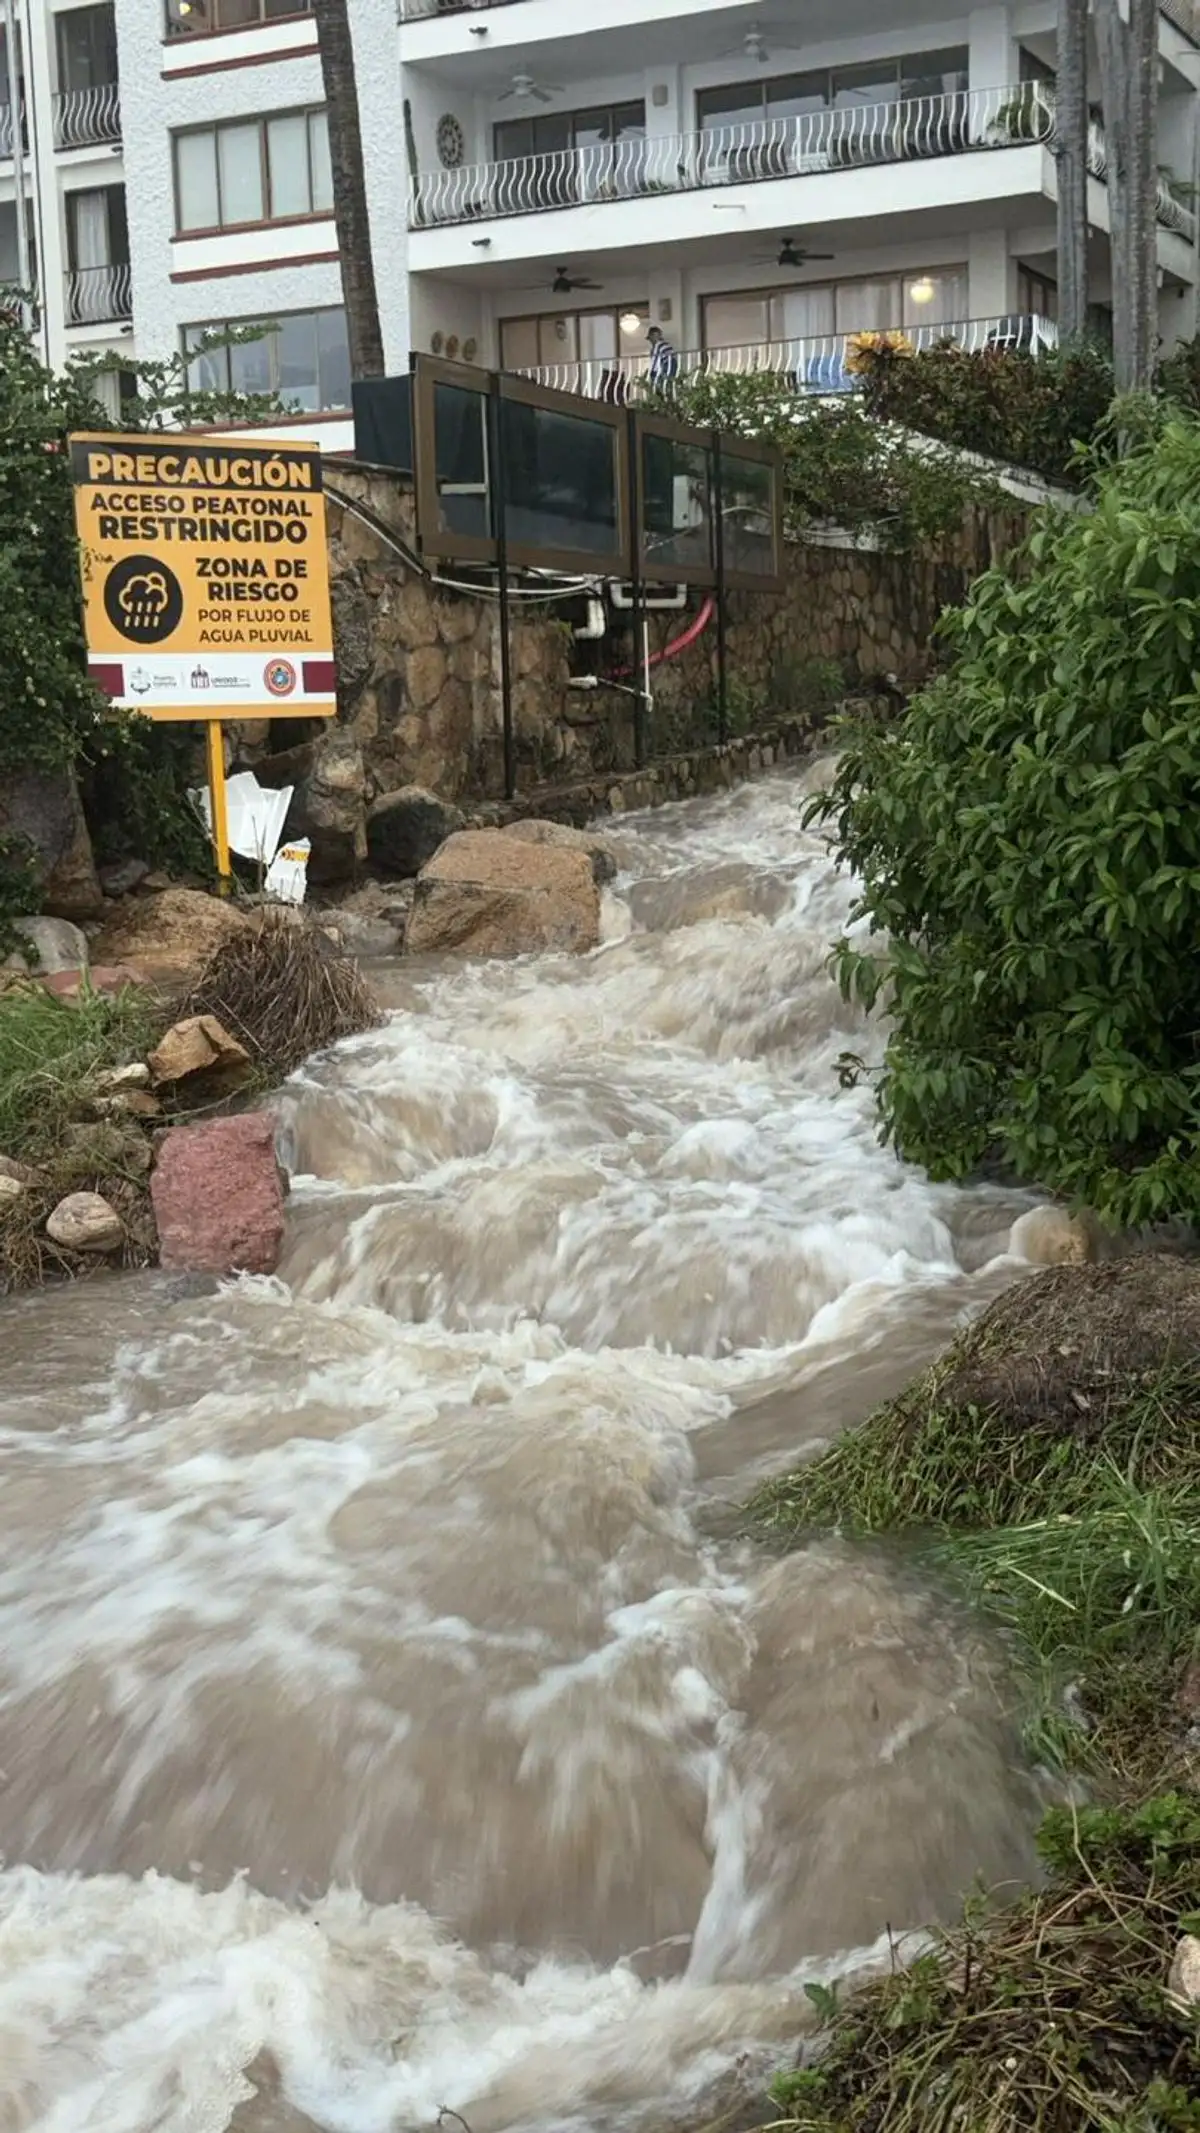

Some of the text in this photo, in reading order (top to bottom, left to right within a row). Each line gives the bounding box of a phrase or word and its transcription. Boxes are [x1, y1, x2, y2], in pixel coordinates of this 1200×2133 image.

[88, 453, 312, 488] PRECAUCIÓN
[91, 493, 312, 517] ACCESO PEATONAL
[99, 516, 307, 544] RESTRINGIDO
[195, 558, 307, 578] ZONA DE
[208, 582, 298, 601] RIESGO
[198, 609, 311, 623] POR FLUJO DE
[199, 629, 313, 642] AGUA PLUVIAL
